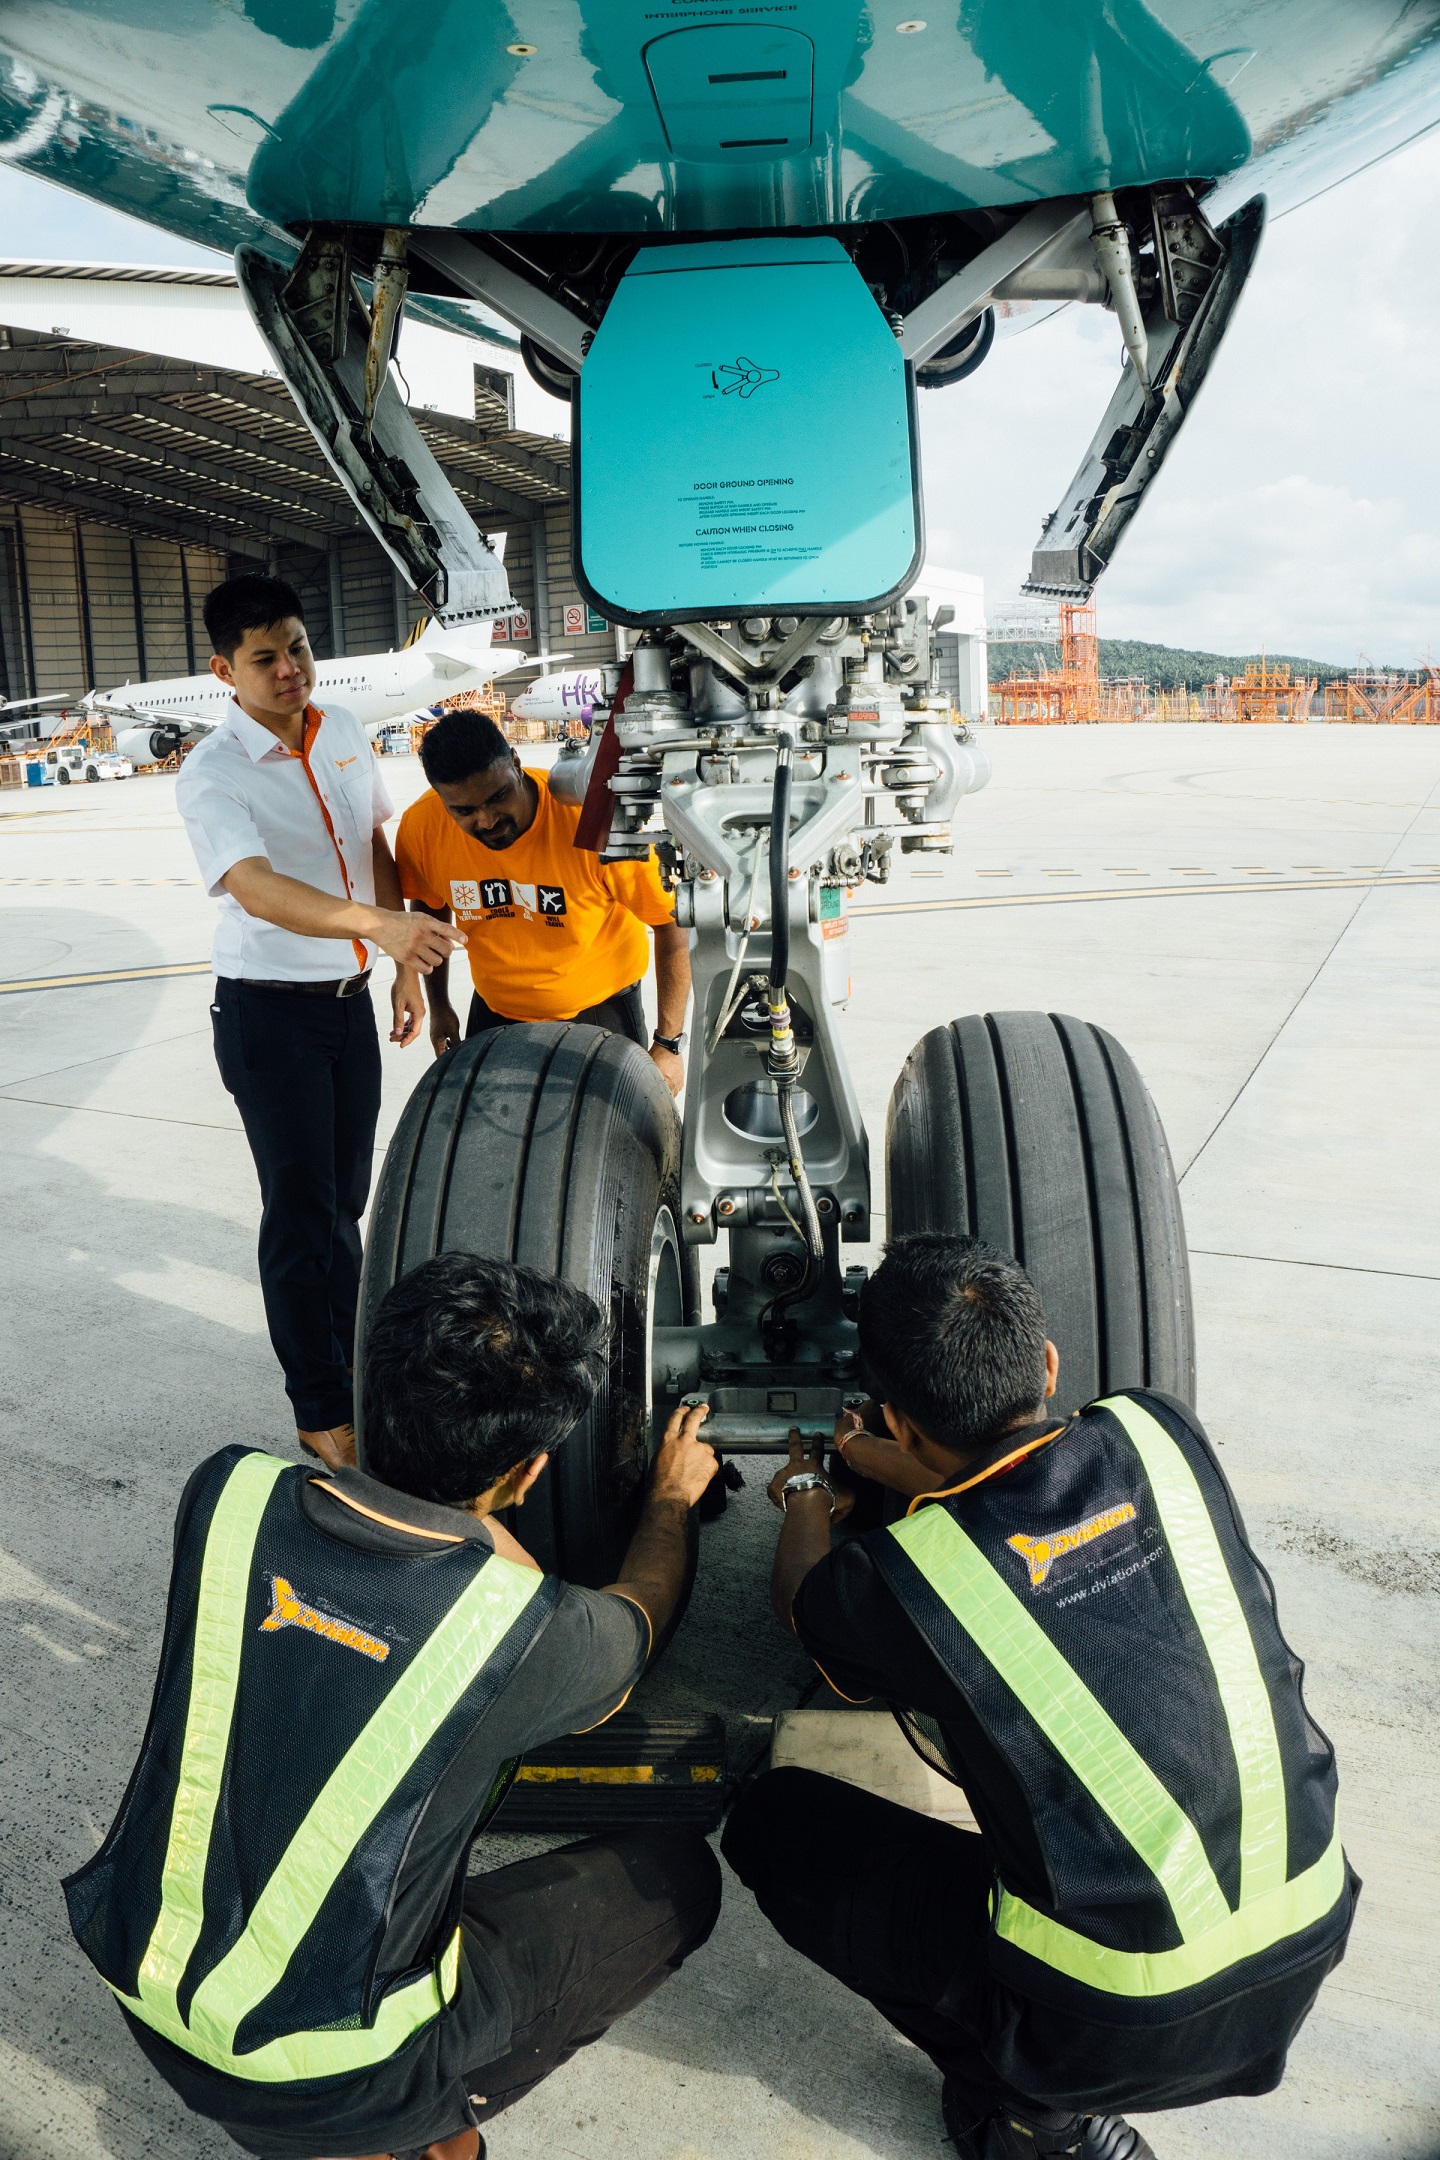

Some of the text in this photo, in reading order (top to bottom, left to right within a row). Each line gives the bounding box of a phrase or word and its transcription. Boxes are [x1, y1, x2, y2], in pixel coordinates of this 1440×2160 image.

[644, 5, 797, 19] INTERPHONE SERVICE
[693, 477, 795, 491] DOOR GROUND OPENING
[695, 523, 795, 537] CAUTION WHEN CLOSING
[485, 911, 515, 920] INCLUDED
[490, 906, 509, 914] TOOLS
[544, 920, 565, 928] TRAVEL
[1052, 1503, 1136, 1556] Dviation
[1055, 1545, 1164, 1609] www.dviation.com
[294, 1608, 391, 1661] Dviation
